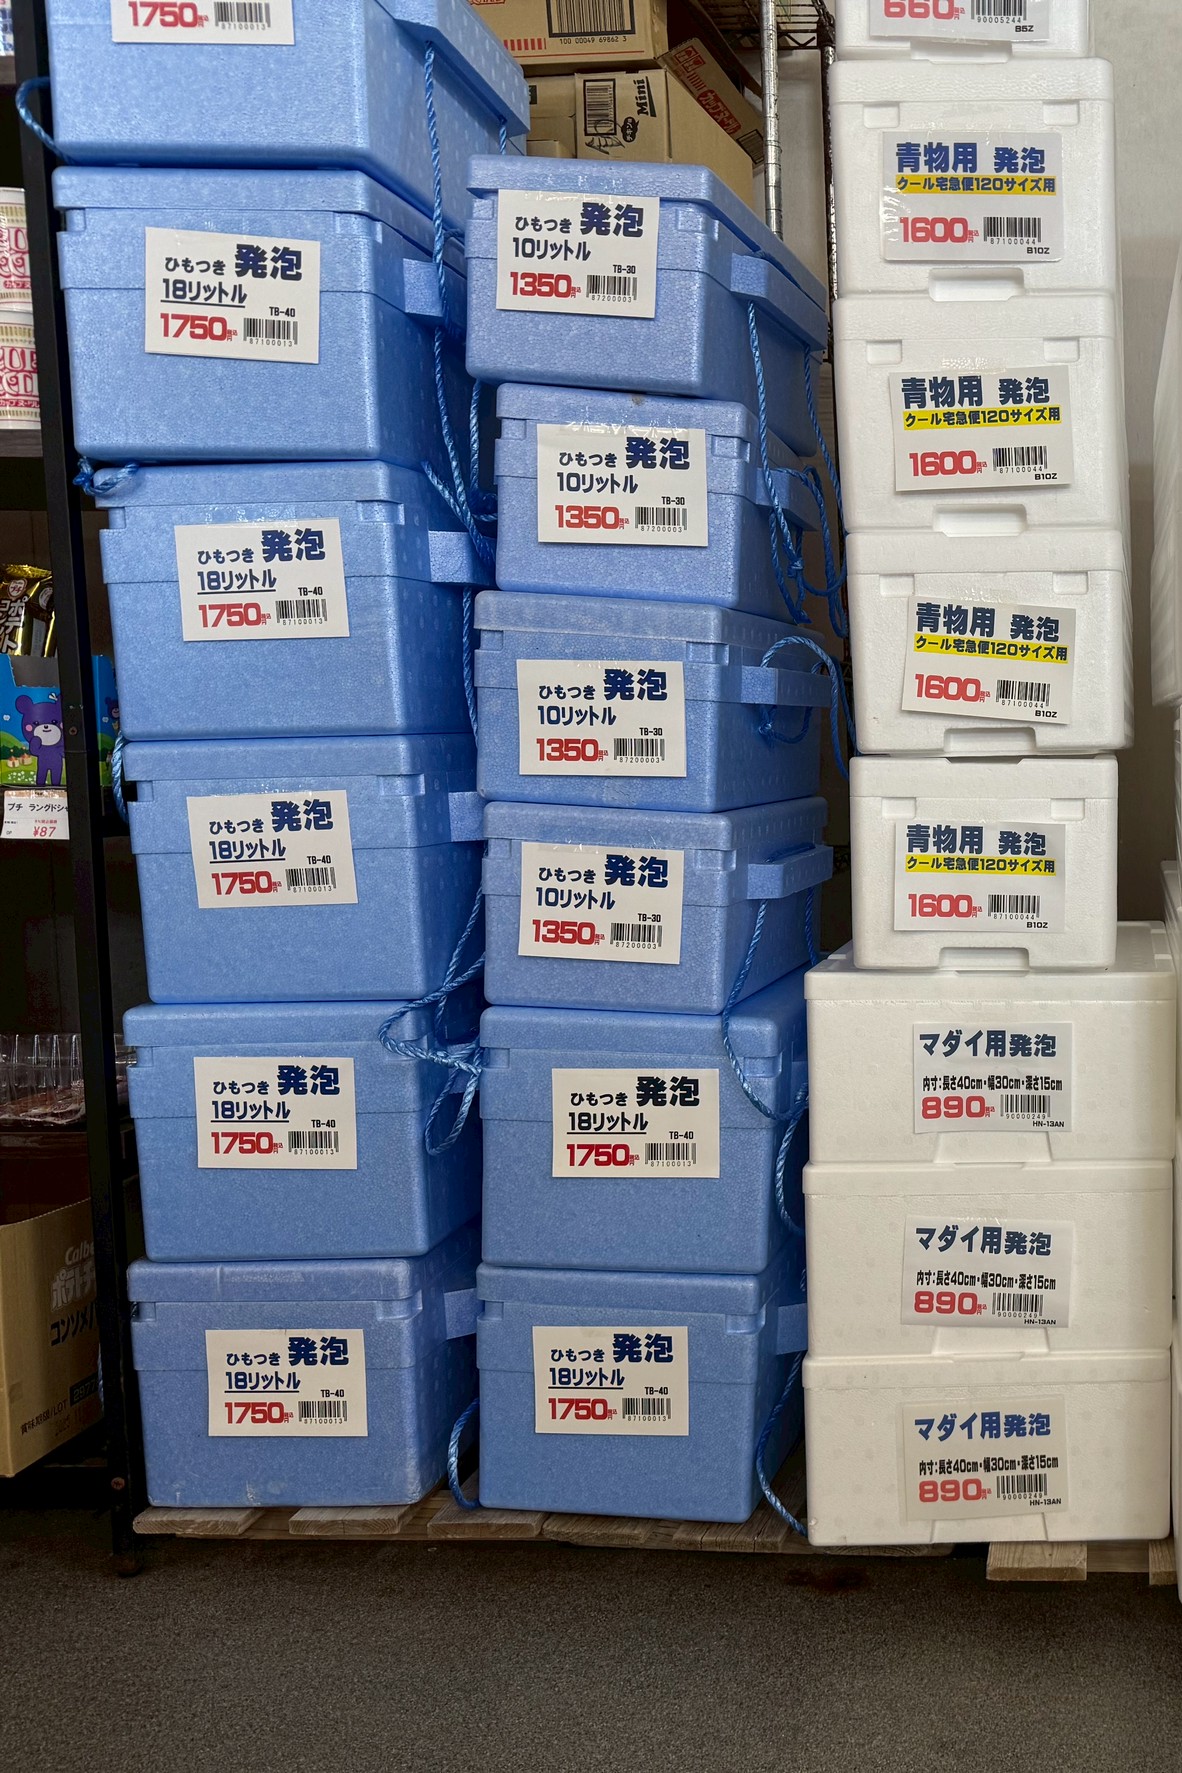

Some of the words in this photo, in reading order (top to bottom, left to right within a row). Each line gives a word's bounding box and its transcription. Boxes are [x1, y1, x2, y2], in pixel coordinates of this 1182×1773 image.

[128, 1, 198, 28] 1750
[221, 23, 266, 31] 87100013
[977, 16, 1022, 24] 90005244
[633, 79, 649, 116] Mini
[897, 142, 977, 173] 青物用
[993, 147, 1045, 174] 発泡
[899, 176, 1056, 192] クール宅急便120サイズ用
[515, 217, 571, 234] ひもつき
[580, 202, 643, 238] 発泡
[900, 217, 969, 243] 1600
[165, 257, 226, 276] ひもつき
[235, 243, 302, 281] 発泡
[513, 238, 591, 261] 10リットル
[613, 265, 636, 274] TB-30
[163, 278, 247, 304] 18リットル
[510, 271, 572, 298] 1350
[269, 307, 295, 318] TB-40
[160, 313, 228, 341] 1750
[901, 375, 983, 409] 青物用
[998, 377, 1050, 405] 発泡
[906, 407, 1060, 427] クール宅急便120サイズ用
[559, 452, 616, 468] ひもつき
[625, 437, 690, 470] 発泡
[910, 450, 978, 477] 1600
[558, 473, 638, 494] 10リットル
[555, 505, 620, 529] 1350
[197, 548, 254, 564] ひもつき
[261, 528, 326, 562] 発泡
[197, 568, 276, 591] 18リットル
[198, 602, 262, 628] 1750
[907, 824, 983, 854] 青物用
[998, 831, 1046, 856] 発泡
[538, 868, 596, 884] ひもつき
[604, 854, 668, 888] 発泡
[908, 857, 1055, 873] クール宅急便120サイズ用
[536, 887, 615, 910] 10リットル
[908, 894, 973, 918] 1600
[532, 919, 596, 945] 1350
[920, 1030, 1056, 1057] マダイ用発泡
[213, 1081, 269, 1095] ひもつき
[277, 1065, 340, 1095] 発泡
[570, 1092, 628, 1107] ひもつき
[636, 1076, 700, 1106] 発泡
[212, 1100, 290, 1119] 18リットル
[922, 1096, 986, 1119] 890
[569, 1112, 648, 1131] 18リットル
[211, 1132, 274, 1154] 1750
[566, 1144, 630, 1166] 1750
[227, 1352, 280, 1366] ひもつき
[288, 1336, 349, 1366] 発泡
[551, 1349, 605, 1363] ひもつき
[612, 1333, 673, 1363] 発泡
[226, 1371, 300, 1390] 18リットル
[550, 1367, 624, 1386] 18リットル
[225, 1402, 285, 1423] 1750
[548, 1398, 608, 1420] 1750
[915, 1411, 1051, 1441] マダイ用発泡
[919, 1478, 983, 1504] 890
